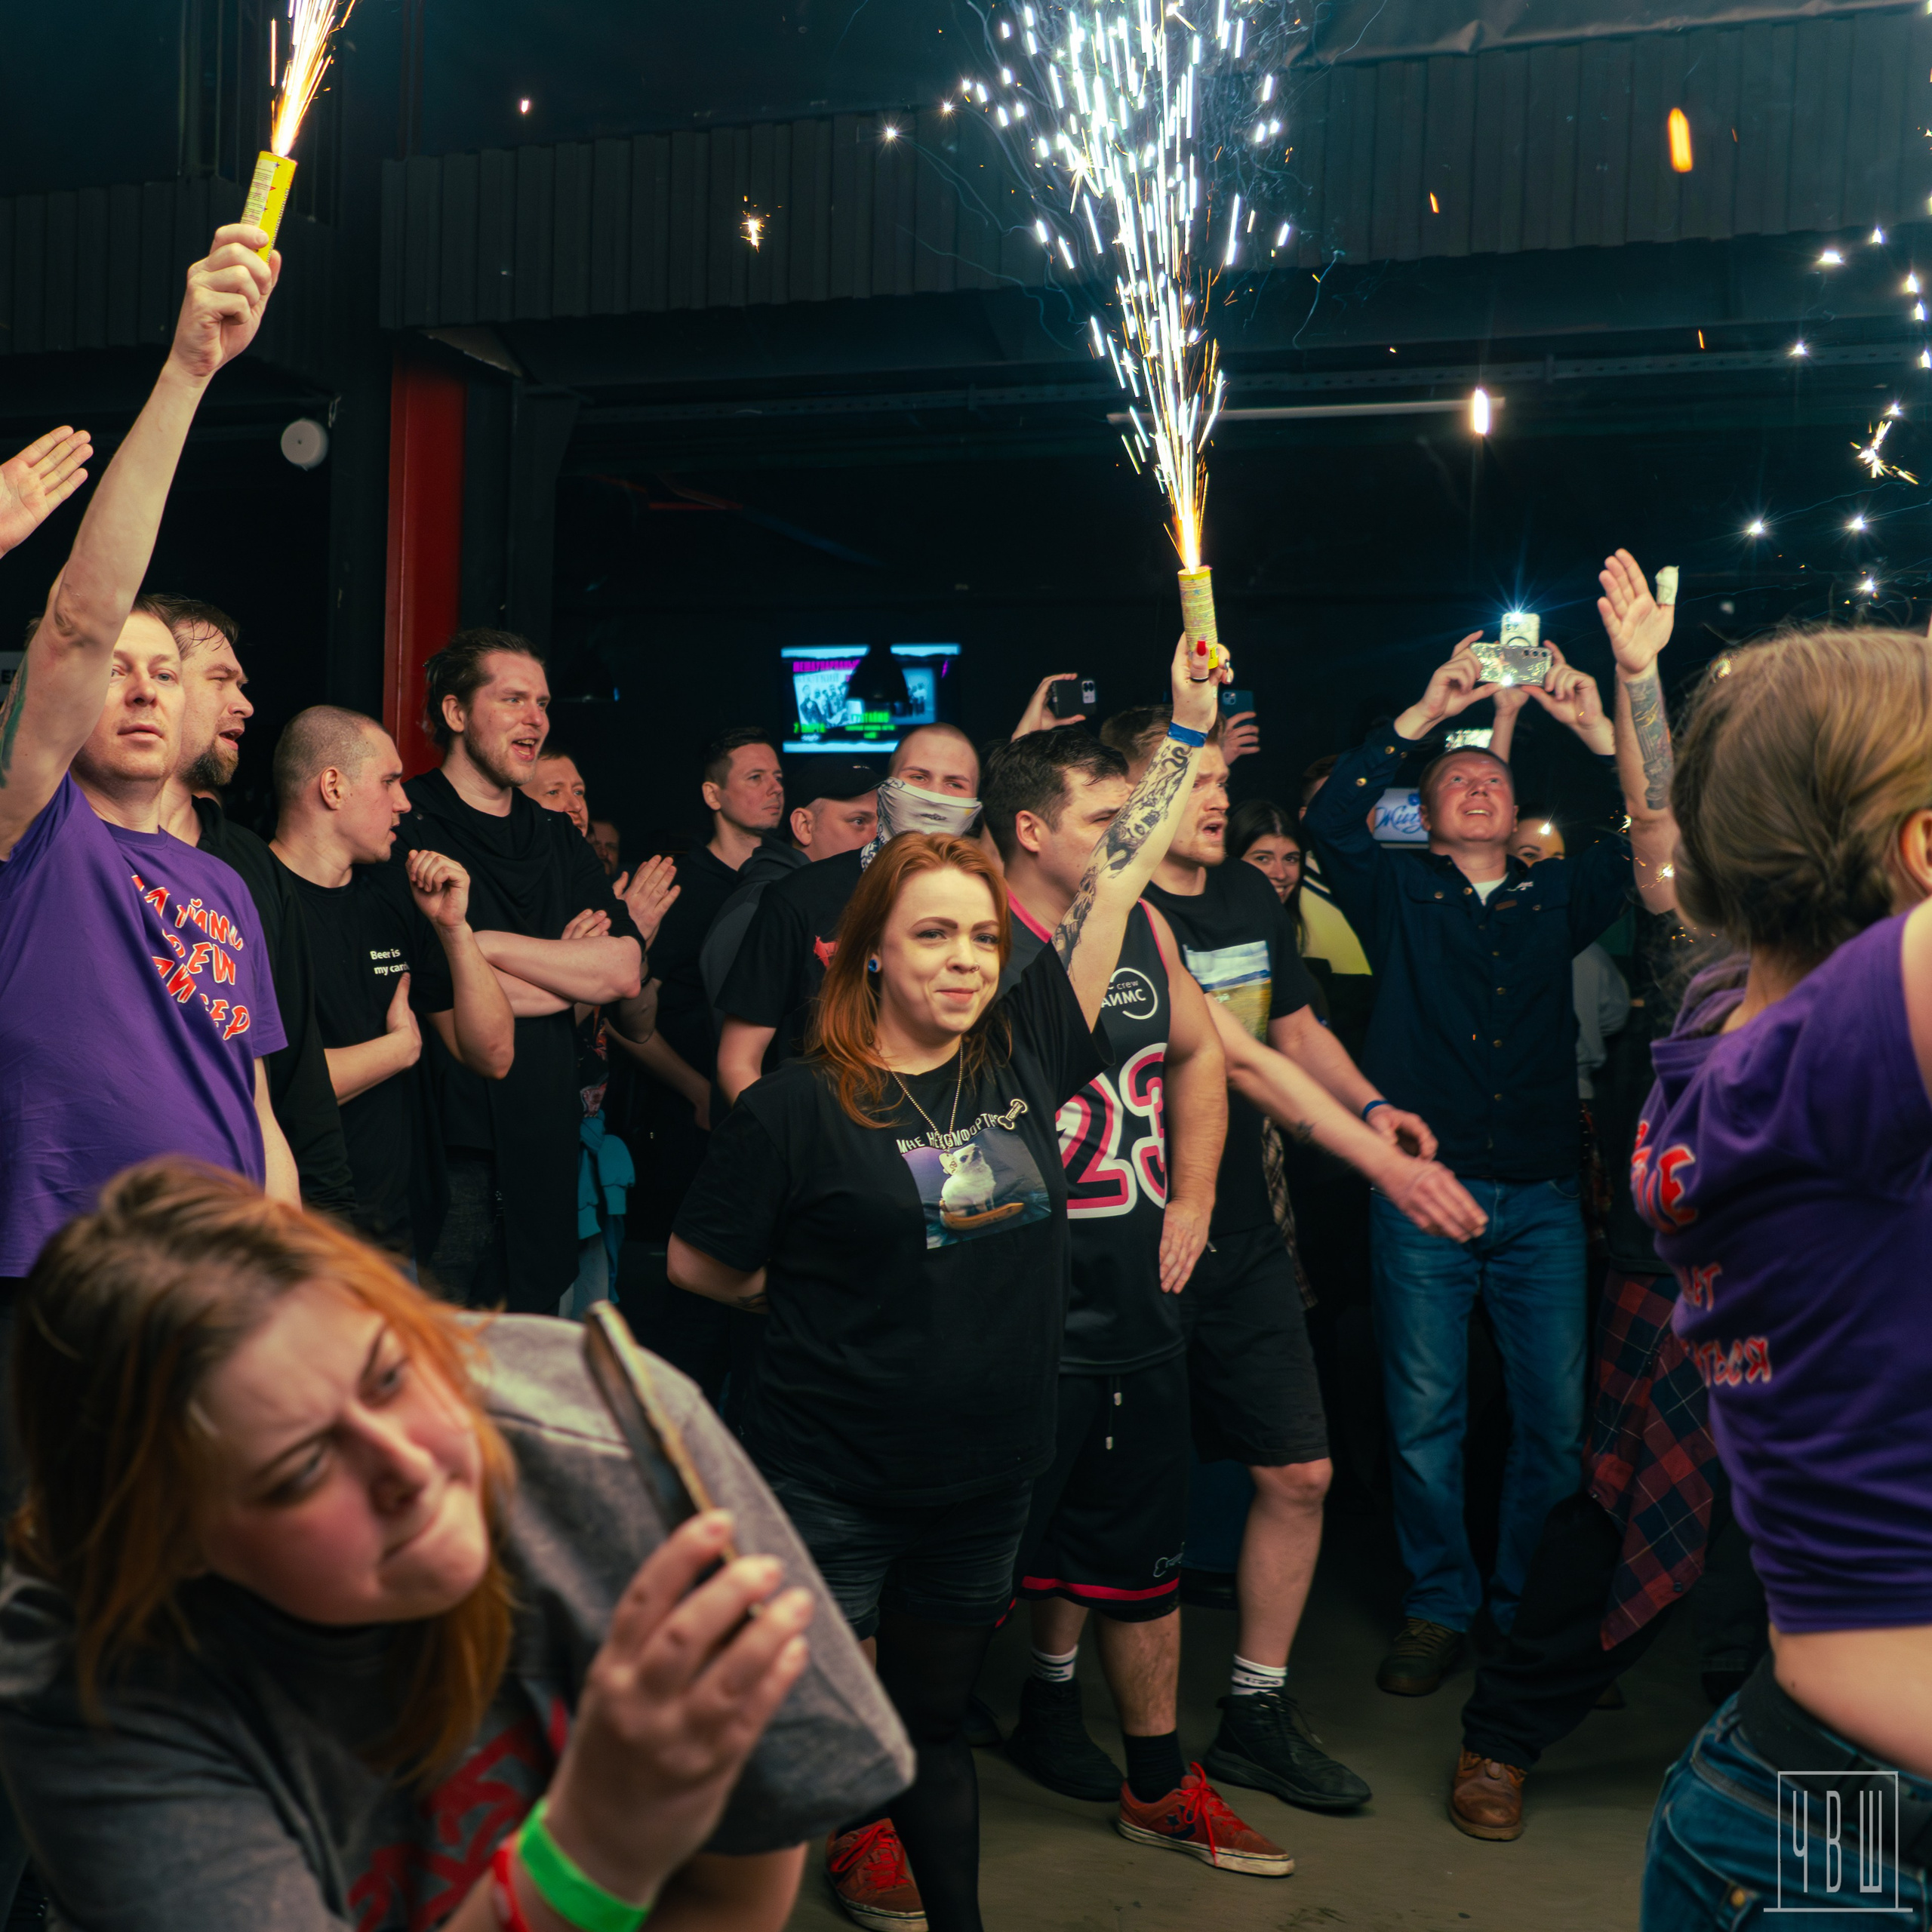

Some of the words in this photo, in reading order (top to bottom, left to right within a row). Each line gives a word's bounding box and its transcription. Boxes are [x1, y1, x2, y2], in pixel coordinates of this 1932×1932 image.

[369, 951, 391, 960] Beer
[390, 948, 401, 958] is
[374, 966, 389, 976] my
[1116, 980, 1139, 990] crew
[1056, 1043, 1167, 1219] 23
[896, 1136, 926, 1154] МНЕ
